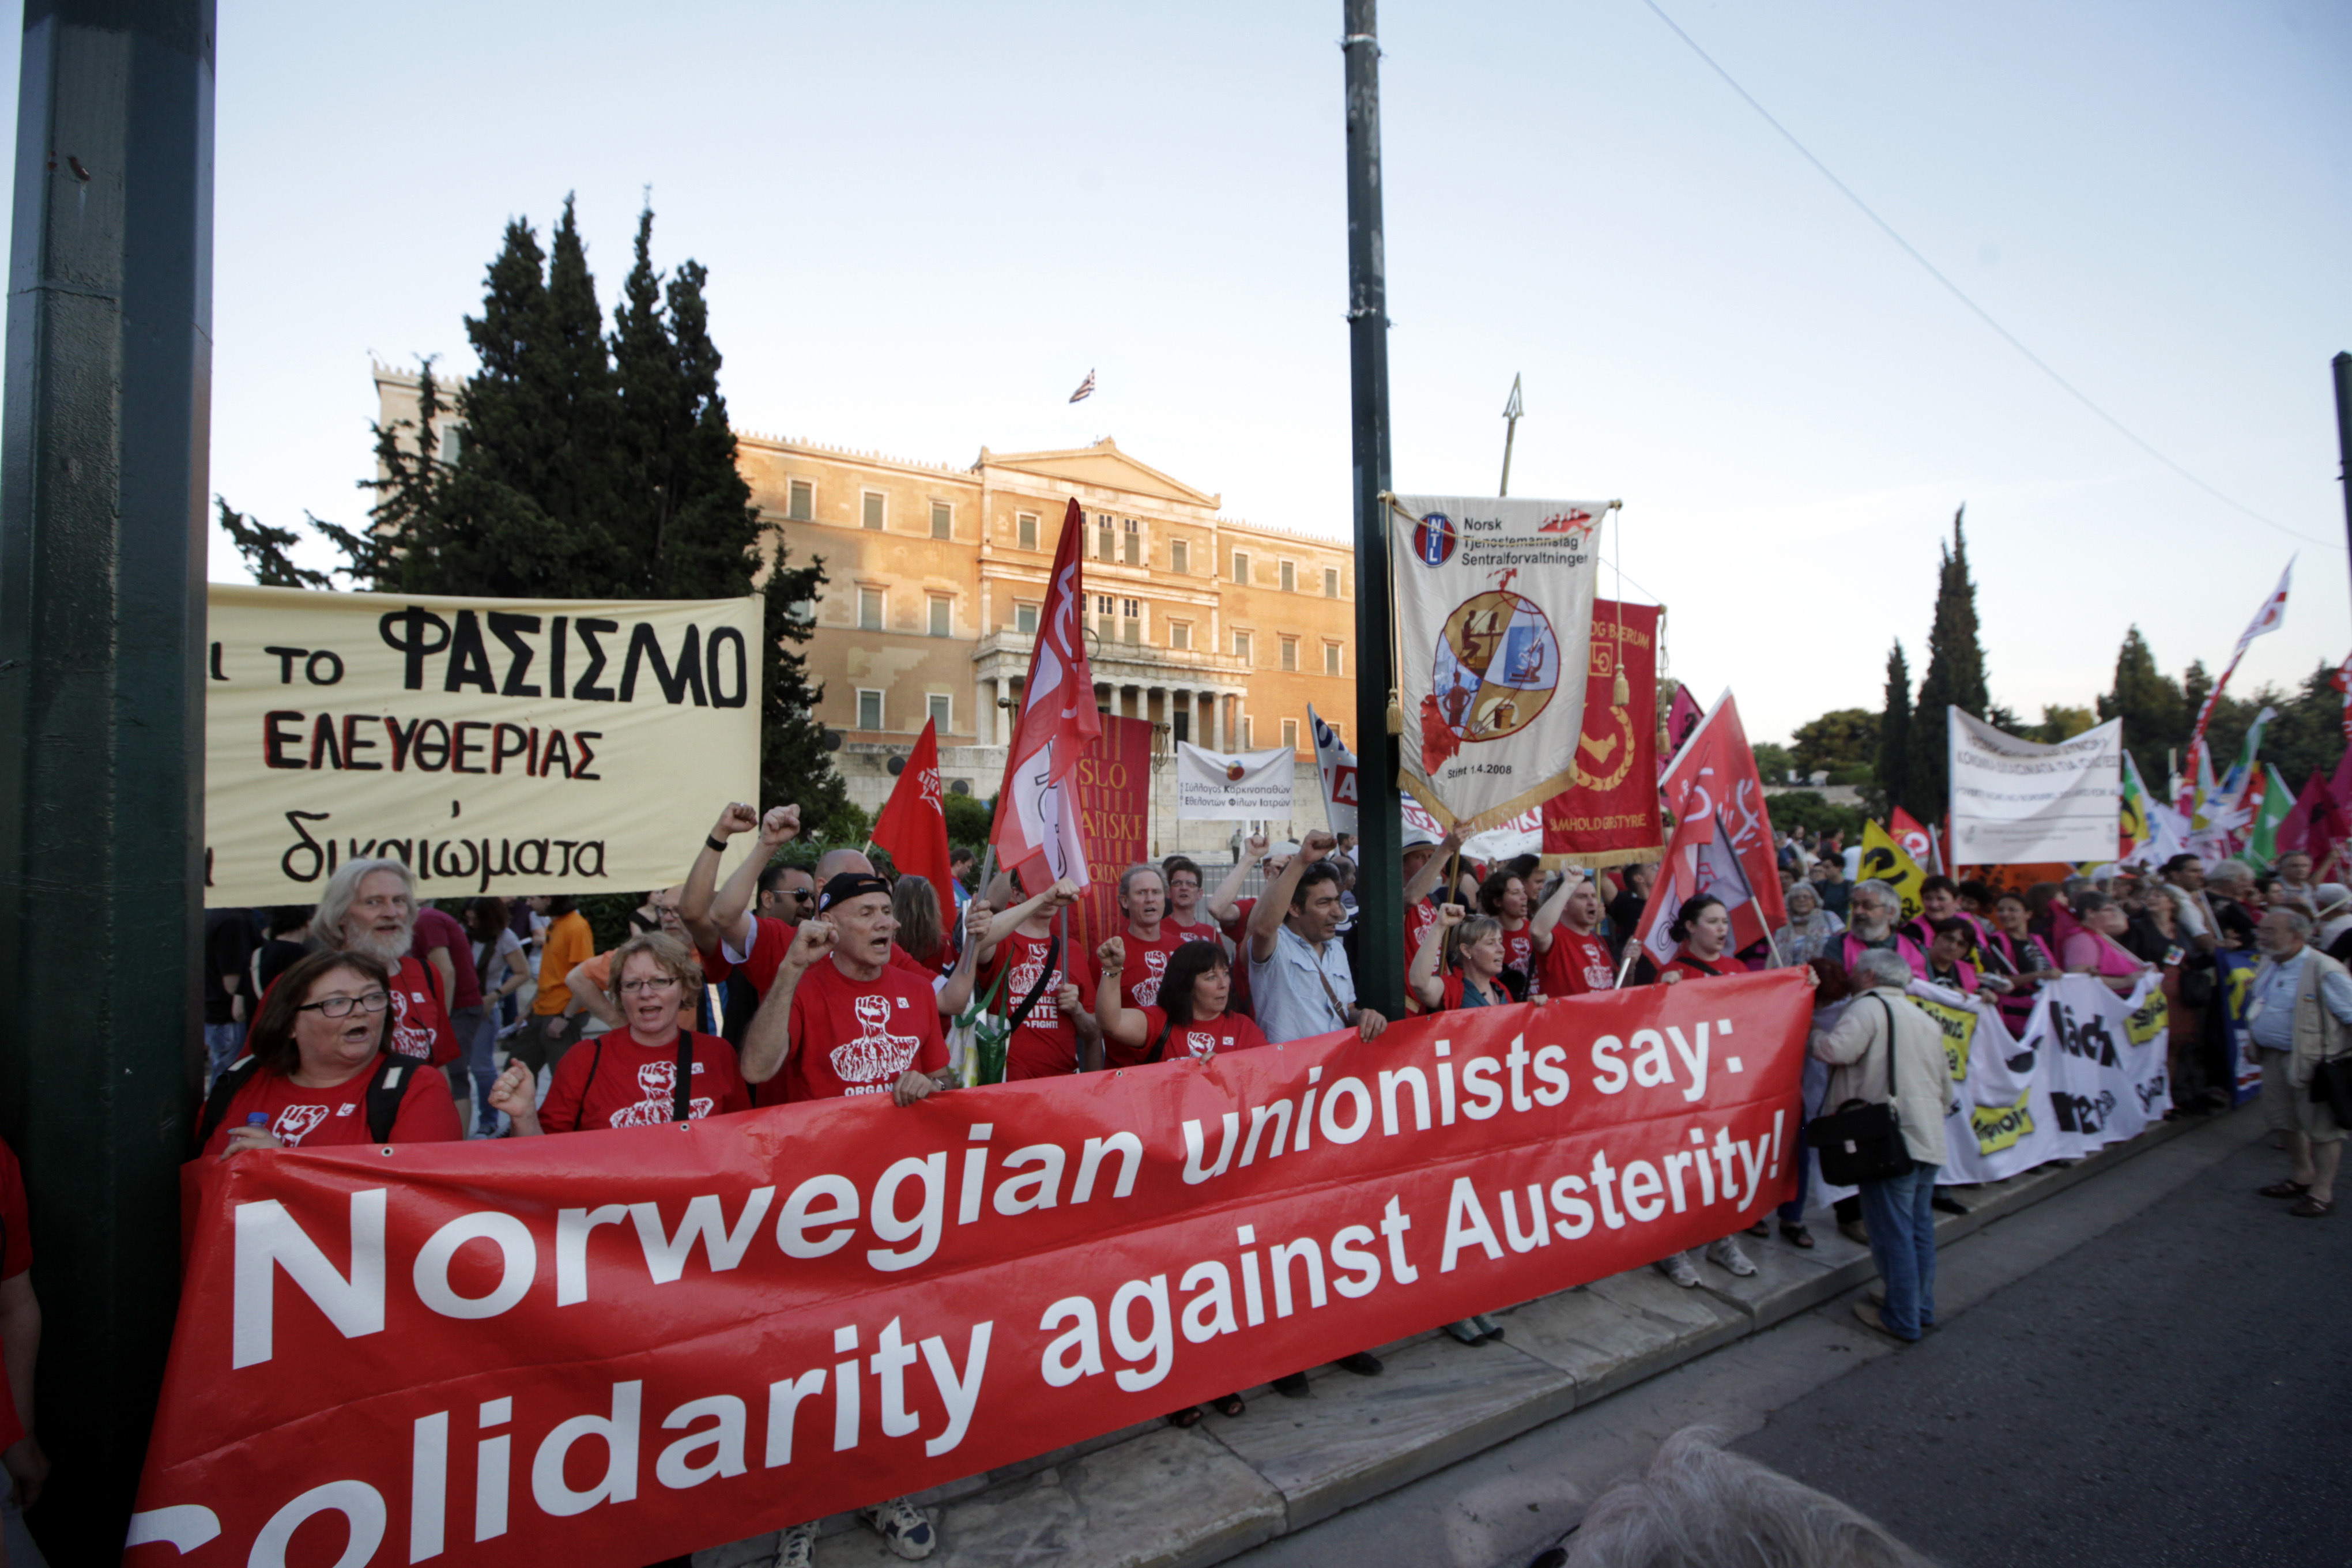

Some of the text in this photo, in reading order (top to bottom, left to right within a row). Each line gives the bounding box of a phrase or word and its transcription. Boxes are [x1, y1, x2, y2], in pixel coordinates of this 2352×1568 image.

[1464, 518, 1502, 530] Norsk
[1429, 518, 1442, 562] NTL
[1590, 620, 1606, 637] OG
[379, 605, 747, 708] ΦΑΣΙΣΜΟ
[1593, 643, 1610, 673] LO
[263, 710, 602, 781] ΕΛΕΥΘΕΡΙΑΣ
[1075, 758, 1126, 789] SLO
[1470, 764, 1512, 775] 1.4.2008
[1224, 785, 1291, 796] Καρκινοπαθών
[1185, 796, 1291, 808] Εθελοντών Φίλων Ιατρών
[1088, 863, 1127, 884] OREN
[1009, 996, 1057, 1005] ORNIZE
[1031, 1020, 1058, 1028] FIGHT!
[233, 1019, 1743, 1370] Norwegian unionists say:
[1039, 1194, 1419, 1393] against
[1440, 1109, 1785, 1273] Austerity!
